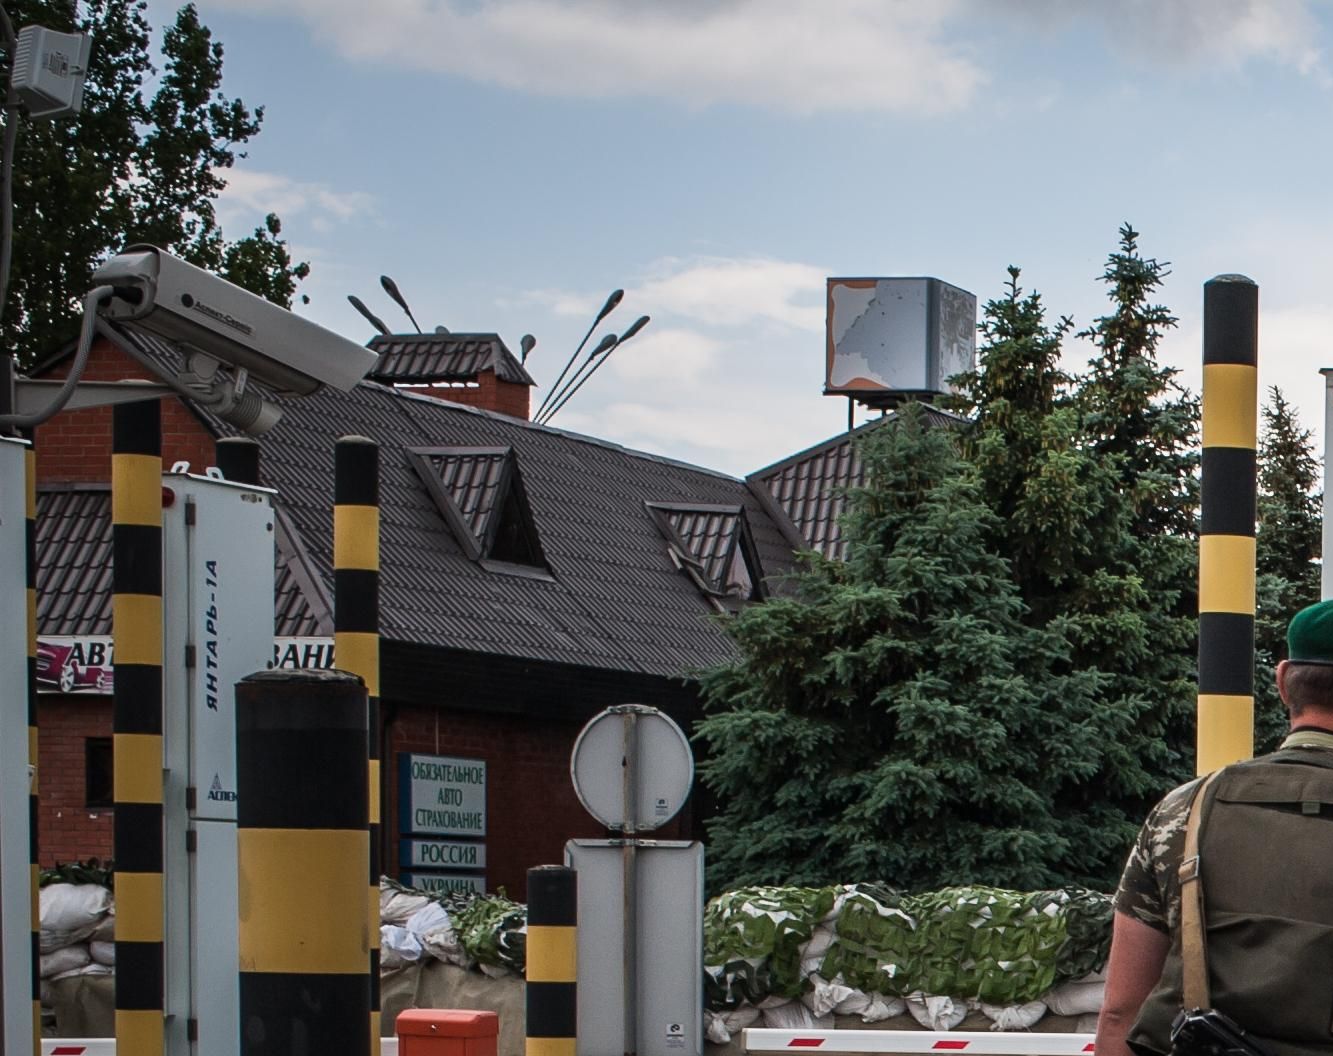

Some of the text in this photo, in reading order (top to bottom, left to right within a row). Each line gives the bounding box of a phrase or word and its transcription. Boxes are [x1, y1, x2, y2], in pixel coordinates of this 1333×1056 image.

[205, 560, 218, 712] ЯНТАРЬ-1А
[412, 761, 483, 785] ОБЯЗАТЕЛЬНОЕ
[438, 787, 463, 807] АВТО
[415, 808, 482, 830] СТРАХОВАНИЕ
[421, 843, 477, 865] РОССИЯ
